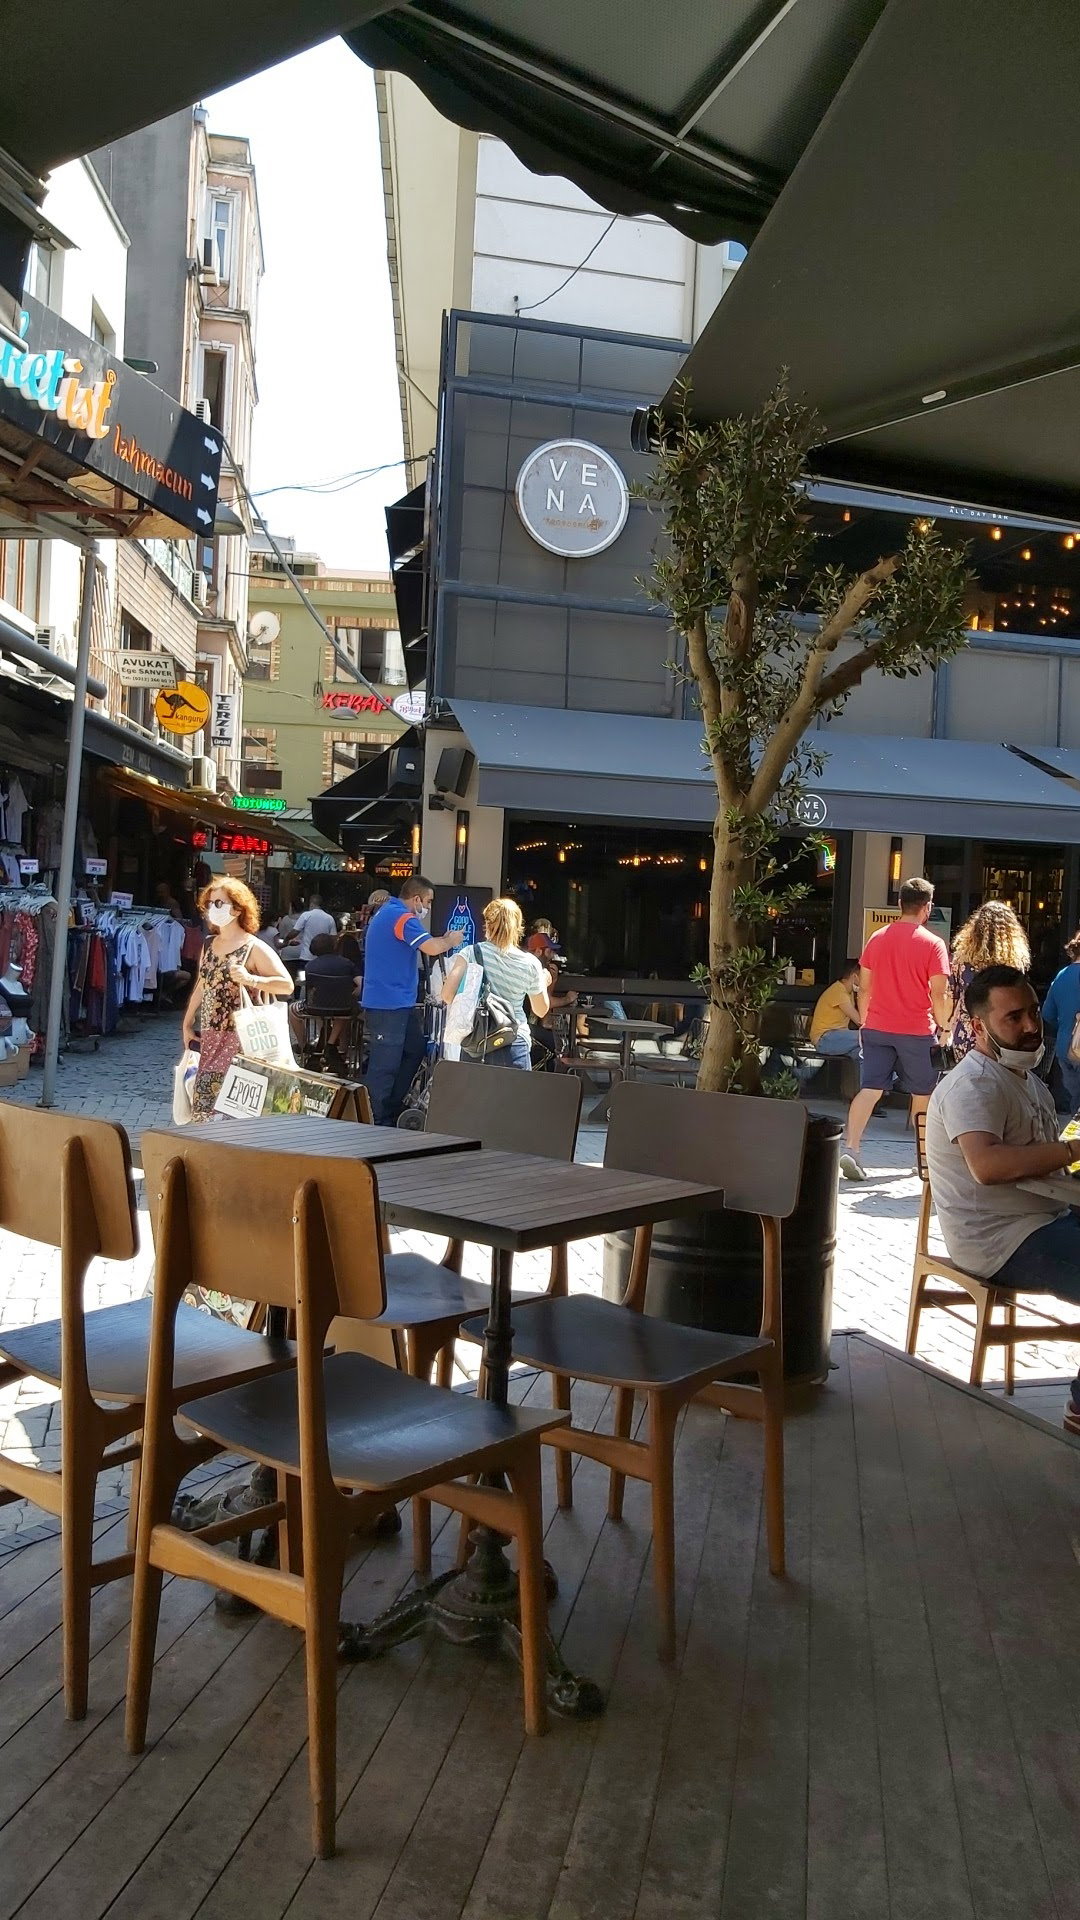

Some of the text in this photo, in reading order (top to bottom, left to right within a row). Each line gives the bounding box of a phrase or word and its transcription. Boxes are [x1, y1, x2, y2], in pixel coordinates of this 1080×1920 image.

[114, 423, 193, 501] lahmacun
[122, 658, 169, 669] AVUKAT
[138, 668, 172, 677] SANVER
[323, 692, 393, 716] KEBAP
[175, 712, 204, 724] kanguru
[872, 911, 901, 923] burg
[246, 1020, 270, 1038] GIB
[250, 1034, 279, 1052] UND
